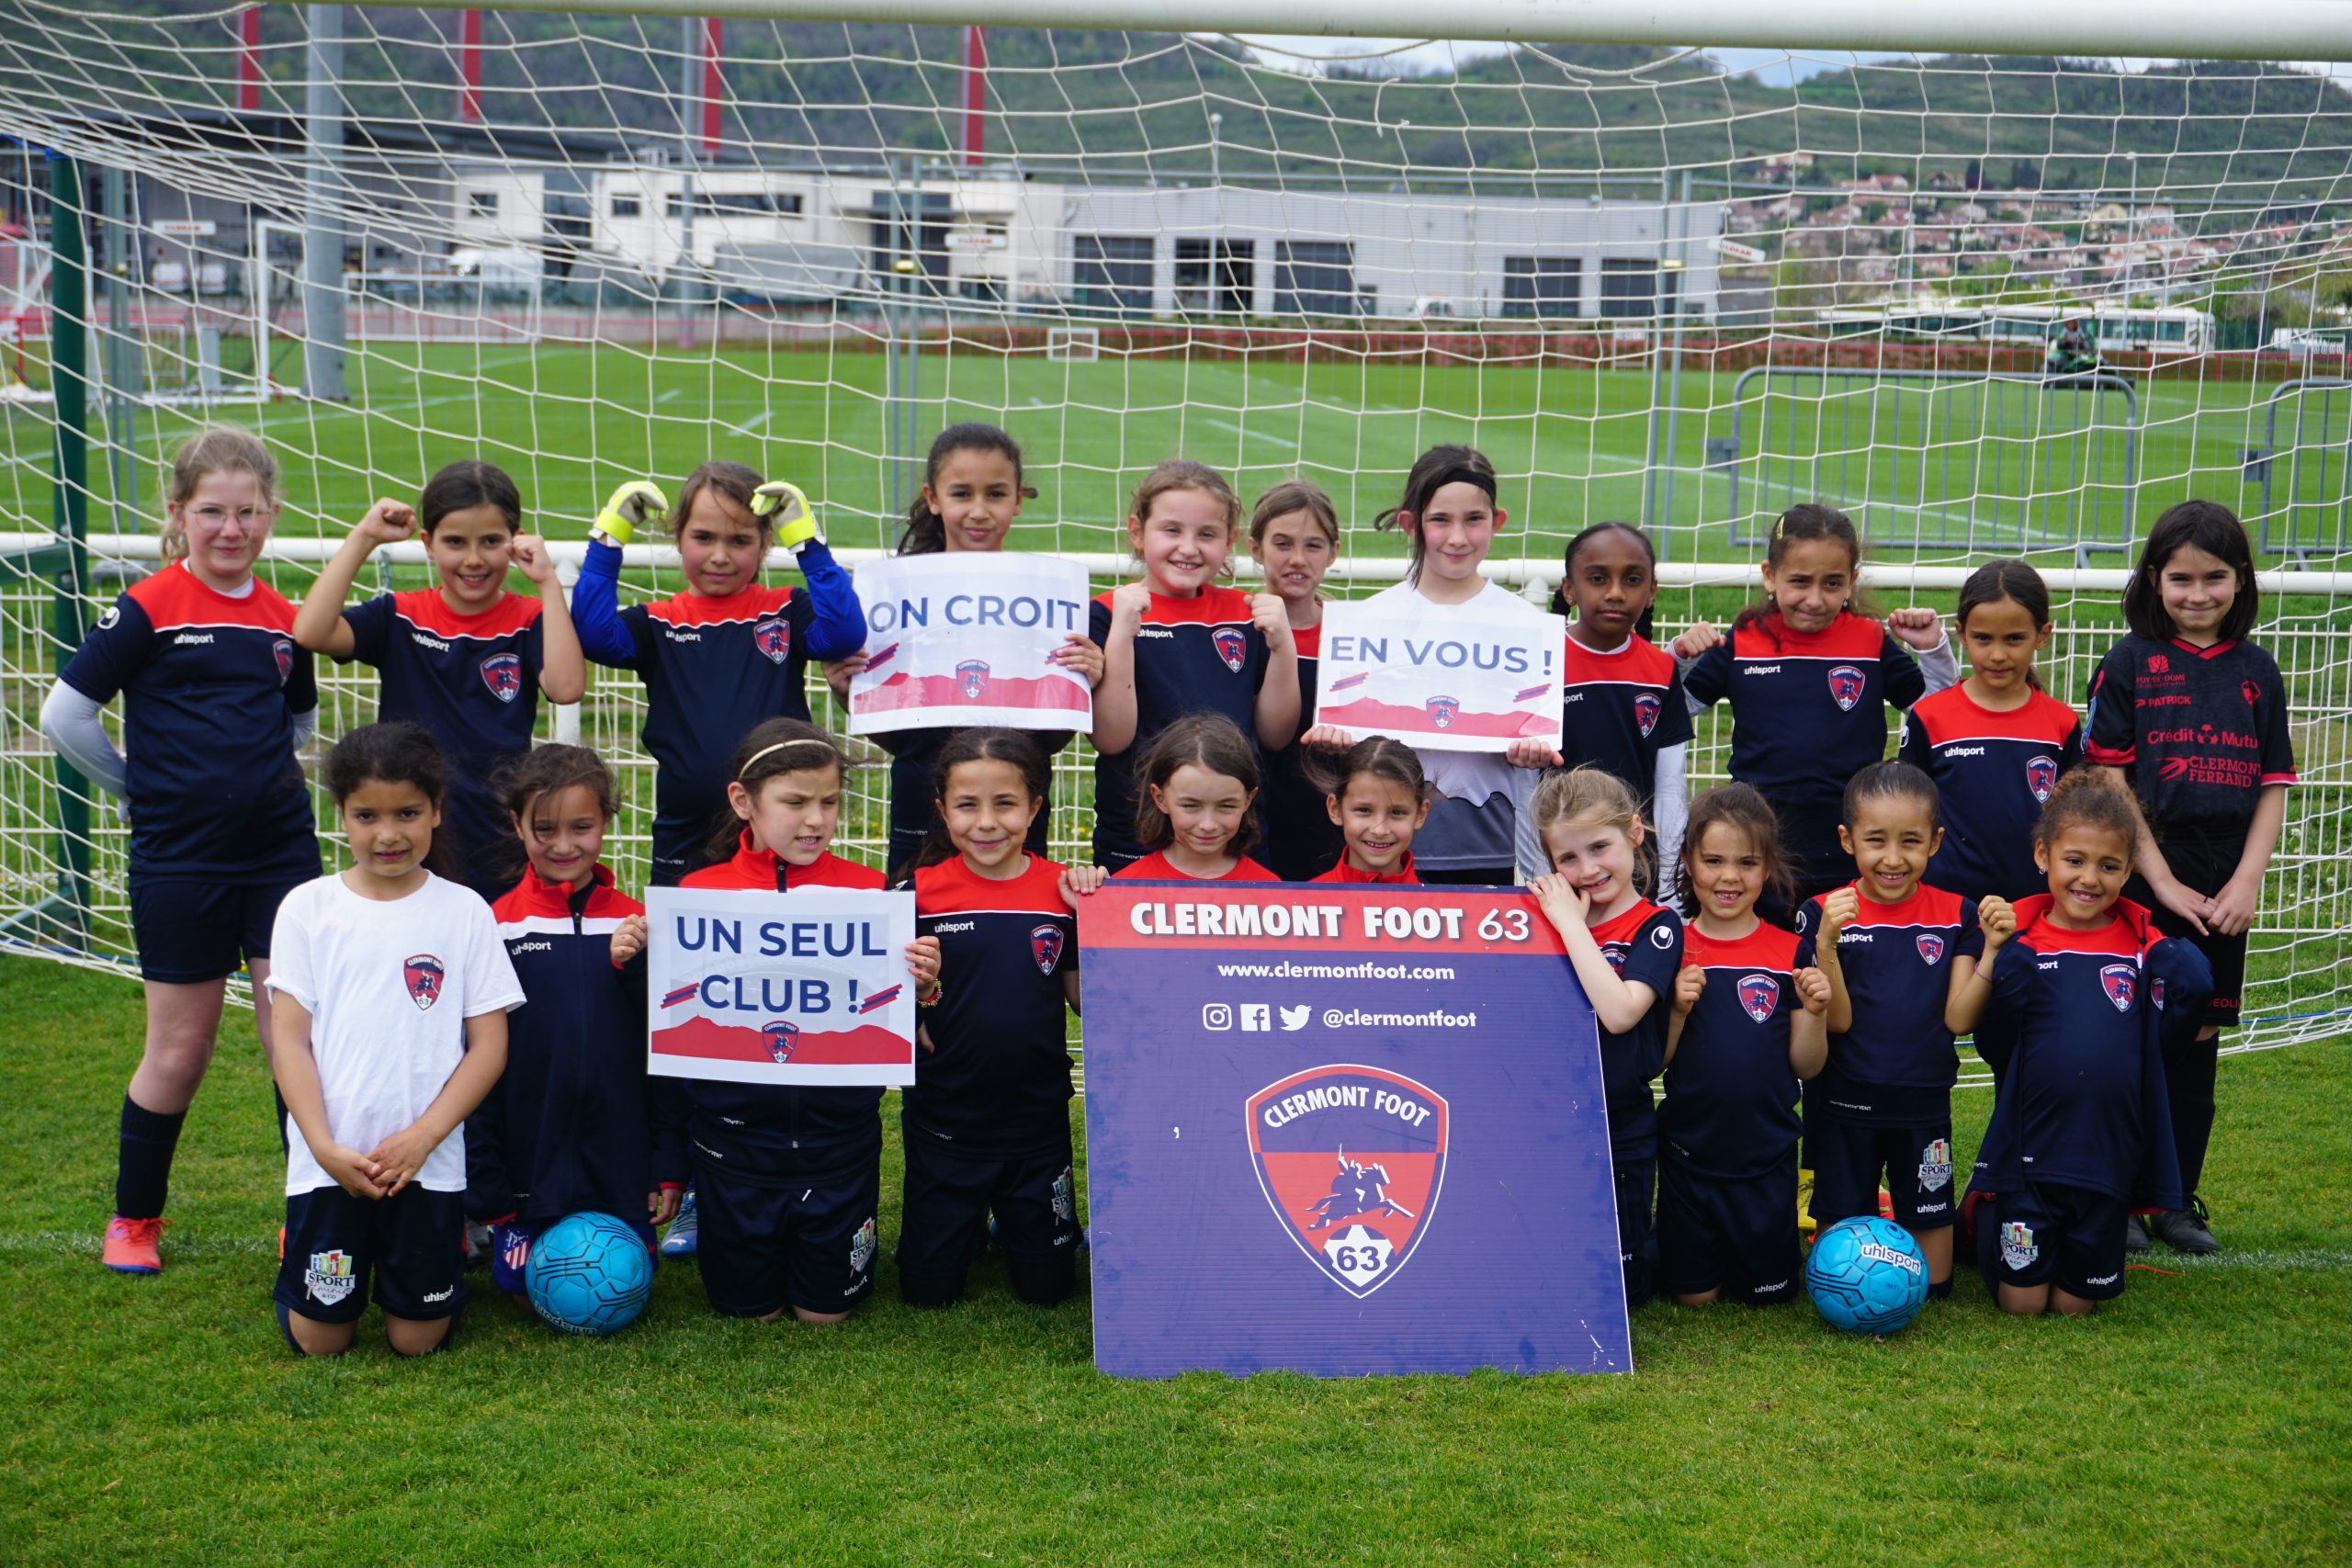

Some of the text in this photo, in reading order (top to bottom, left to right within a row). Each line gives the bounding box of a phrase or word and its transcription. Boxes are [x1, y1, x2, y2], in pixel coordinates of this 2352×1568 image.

[867, 594, 1080, 633] ON CROIT
[175, 633, 215, 646] uhlsport
[412, 633, 450, 652] uhlsport
[1330, 636, 1388, 663] EN
[1403, 639, 1529, 673] VOUS
[1744, 665, 1781, 675] uhlsport
[1564, 692, 1584, 705] sport
[2148, 694, 2191, 706] PATRICK
[2146, 728, 2259, 750] Crédit Mutu
[1944, 746, 1985, 758] uhlsport
[2188, 770, 2253, 788] FERRAND
[934, 919, 975, 934] uhlsport
[1130, 902, 1530, 942] CLERMONT FOOT 63
[677, 916, 888, 957] UN SEUL
[1217, 960, 1455, 980] www.clermontfoot.com
[700, 974, 831, 1014] CLUB
[2213, 997, 2241, 1009] EOLI
[1323, 1009, 1477, 1029] @clermontfoot
[1755, 1011, 1765, 1021] 63
[1263, 1086, 1431, 1129] CLERMONT FOOT
[1922, 1163, 1951, 1177] SPORT
[1917, 1202, 1948, 1213] uhlsport
[1336, 1246, 1382, 1271] 63
[1861, 1244, 1922, 1276] uhlsport
[309, 1272, 354, 1288] SPORT
[1755, 1280, 1788, 1292] uhlsport
[2086, 1272, 2119, 1286] uhlsport
